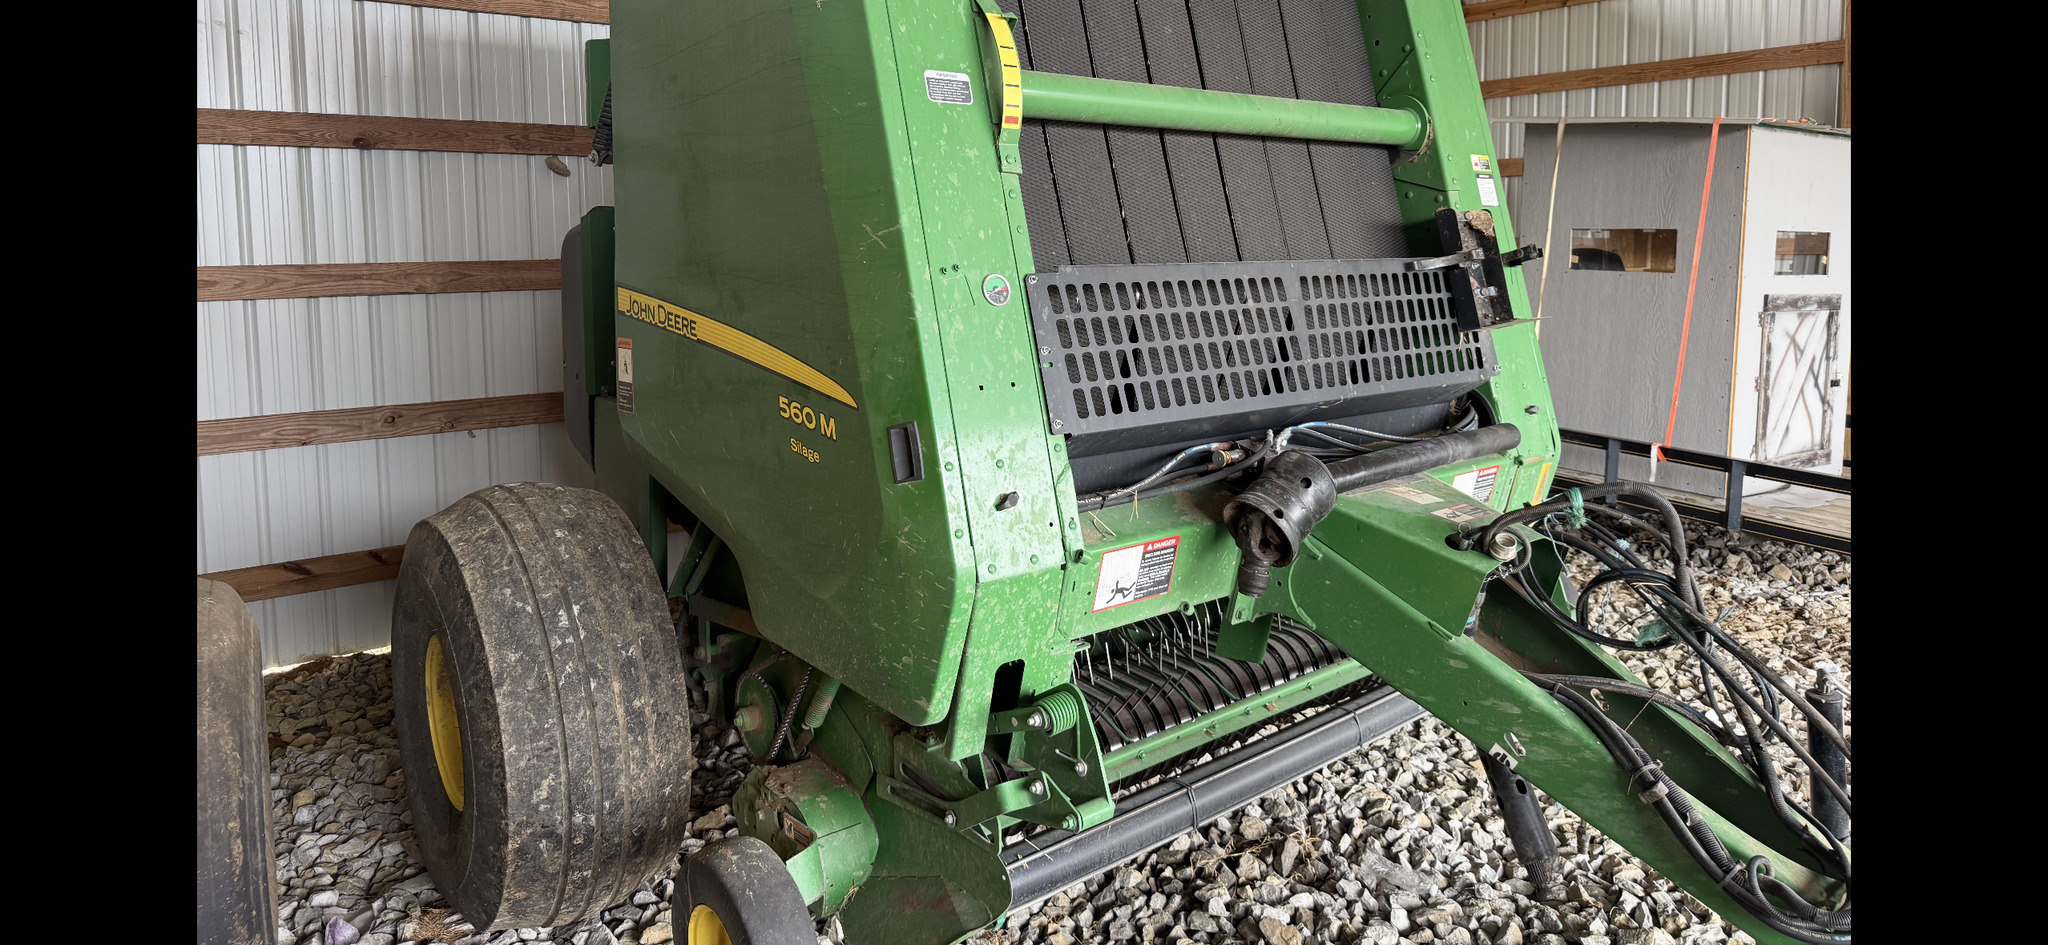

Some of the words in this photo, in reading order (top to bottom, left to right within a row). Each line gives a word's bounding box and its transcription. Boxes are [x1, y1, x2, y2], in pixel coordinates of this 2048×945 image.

[626, 295, 656, 323] JOHN
[658, 304, 698, 339] DEERE
[779, 395, 816, 430] 560
[819, 412, 837, 441] M
[790, 437, 820, 464] Silage
[1154, 539, 1176, 548] DANGER
